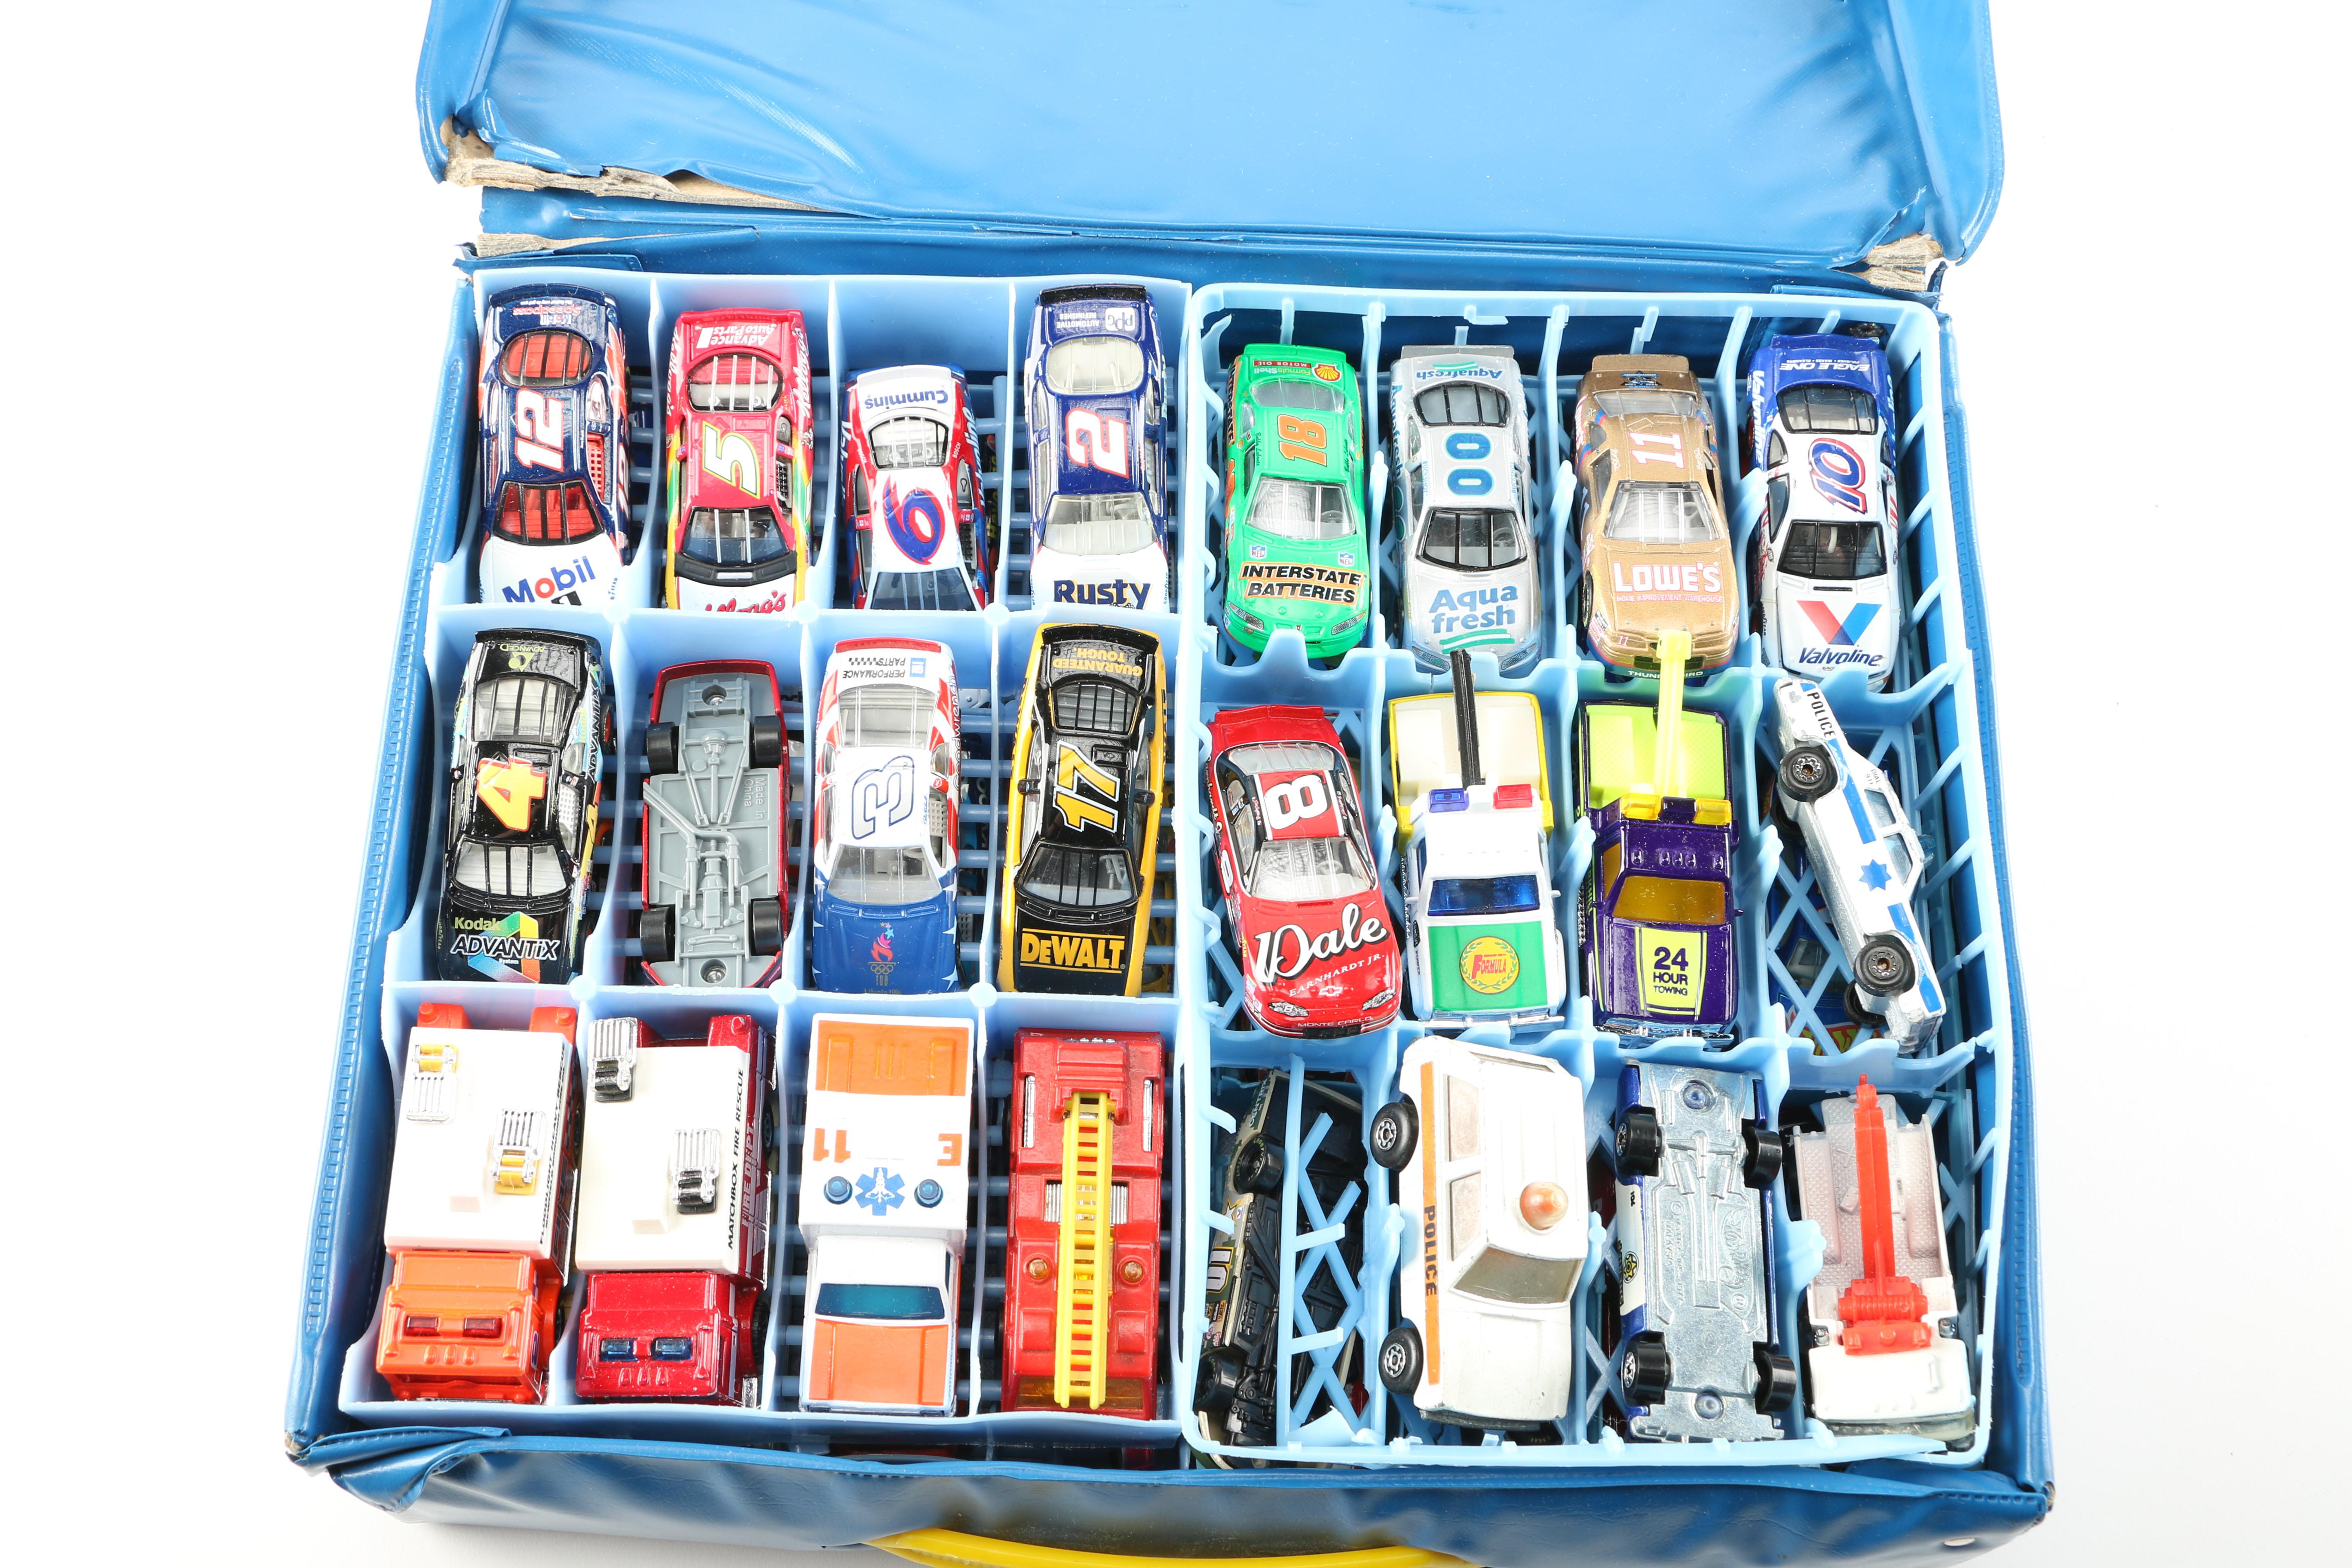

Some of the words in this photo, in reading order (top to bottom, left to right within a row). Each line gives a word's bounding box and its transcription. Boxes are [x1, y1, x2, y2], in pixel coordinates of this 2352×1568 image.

[512, 304, 582, 316] Speedpass
[540, 314, 572, 325] Mobil
[1106, 312, 1133, 330] PPG
[710, 334, 769, 346] Advance
[714, 325, 741, 335] Parts
[745, 323, 777, 334] Auto
[1416, 368, 1503, 380] Aquafresh
[864, 389, 949, 409] Cummins
[515, 388, 565, 471] 12
[1752, 371, 1765, 464] Valvoline
[1065, 407, 1130, 479] 2
[1277, 414, 1327, 467] 18
[1392, 385, 1403, 477] Aquafresh
[702, 420, 760, 499] 5
[952, 442, 961, 459] BOSCH
[1628, 431, 1685, 469] 11
[1445, 432, 1495, 496] 00
[1808, 438, 1868, 514] 10
[883, 475, 945, 565] 6
[1339, 557, 1352, 565] NFL
[502, 555, 596, 603] Mobil
[1242, 565, 1361, 586] INTERSTATE
[1613, 560, 1722, 593] LOWE'S
[1053, 579, 1153, 610] Rusty
[1248, 583, 1355, 603] BATTERIES
[1429, 585, 1518, 613] Aqua
[1432, 605, 1516, 634] fresh
[499, 643, 546, 653] ADVANCED
[1617, 635, 1629, 646] 11
[879, 658, 906, 666] PARTS
[1074, 647, 1125, 662] TOUGH.
[1798, 647, 1884, 667] Valvoline
[843, 670, 906, 679] PERFORMANCE
[1053, 658, 1143, 677] GUARANTEED
[1628, 670, 1704, 678] THUNIRD
[1807, 692, 1836, 738] POLICE
[1054, 741, 1121, 833] 17
[1865, 773, 1874, 786] 911
[1870, 769, 1882, 784] DIAL
[477, 754, 548, 832] 4
[744, 779, 754, 807] China
[755, 777, 765, 804] Made
[851, 754, 915, 840] 3
[1264, 774, 1328, 830] 8
[755, 811, 764, 821] in
[454, 917, 502, 931] Kodak
[1021, 933, 1125, 969] DeWALT
[1255, 903, 1388, 984] Dale
[1471, 954, 1507, 980] FORMULA
[1654, 946, 1689, 971] 24
[876, 975, 888, 986] 100
[1289, 961, 1365, 998] EARNHARDT
[1367, 951, 1385, 966] JR.
[1653, 971, 1688, 985] HOUR
[1654, 986, 1688, 996] TOWING
[1338, 1015, 1371, 1026] CARLO
[813, 1128, 851, 1163] 11
[937, 1133, 962, 1167] E
[727, 1161, 738, 1250] MATCHBOX
[1424, 1205, 1437, 1297] POLICE
